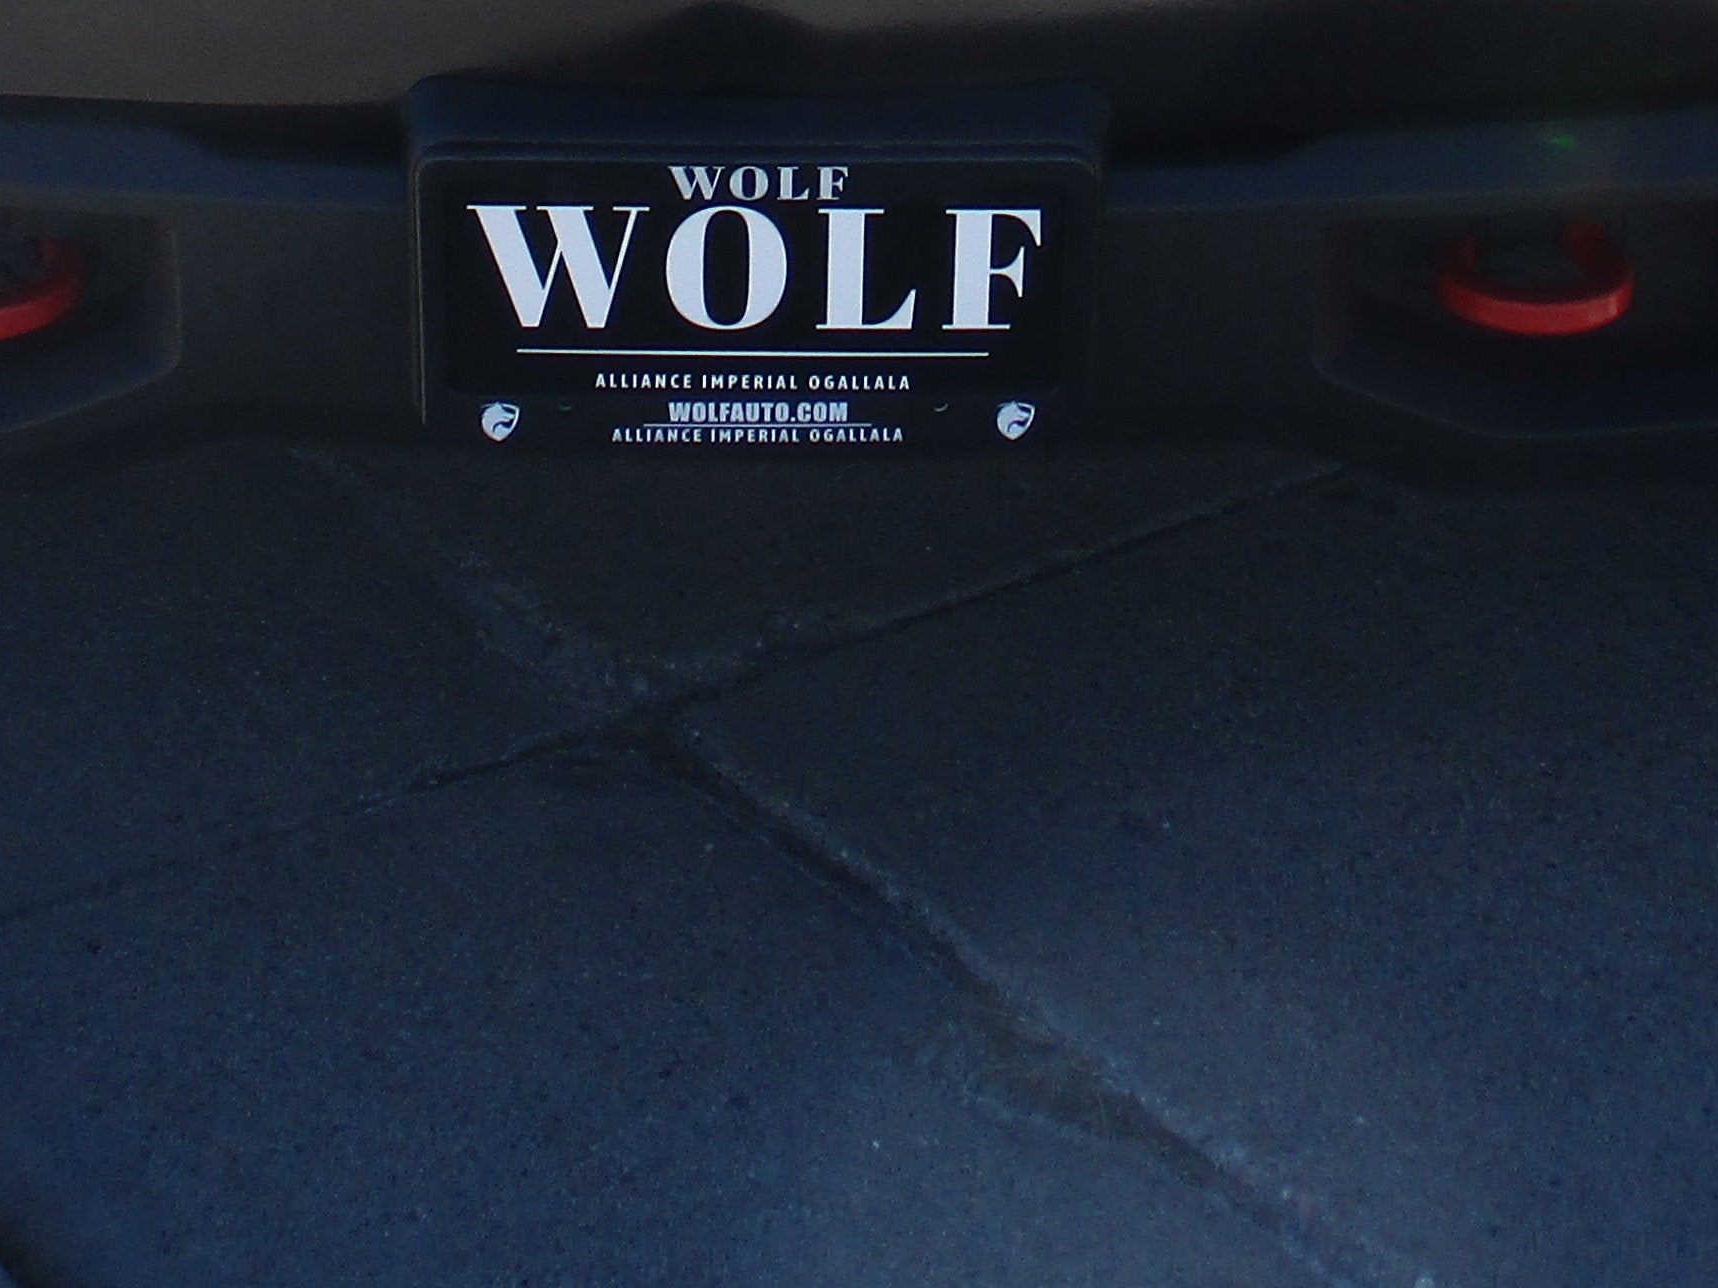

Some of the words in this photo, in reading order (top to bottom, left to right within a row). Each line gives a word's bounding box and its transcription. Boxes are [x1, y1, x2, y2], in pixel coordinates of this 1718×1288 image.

[668, 165, 849, 201] WOLF
[466, 205, 1043, 330] WOLF
[595, 373, 693, 391] ALLIANCE
[702, 373, 798, 392] IMPERIAL
[808, 374, 911, 392] OGALLALA
[668, 401, 849, 423] WOLFAUTO.COM
[611, 427, 702, 444] ALLIANCE
[711, 427, 799, 444] IMPERIAL
[810, 427, 904, 445] OGALLALA
